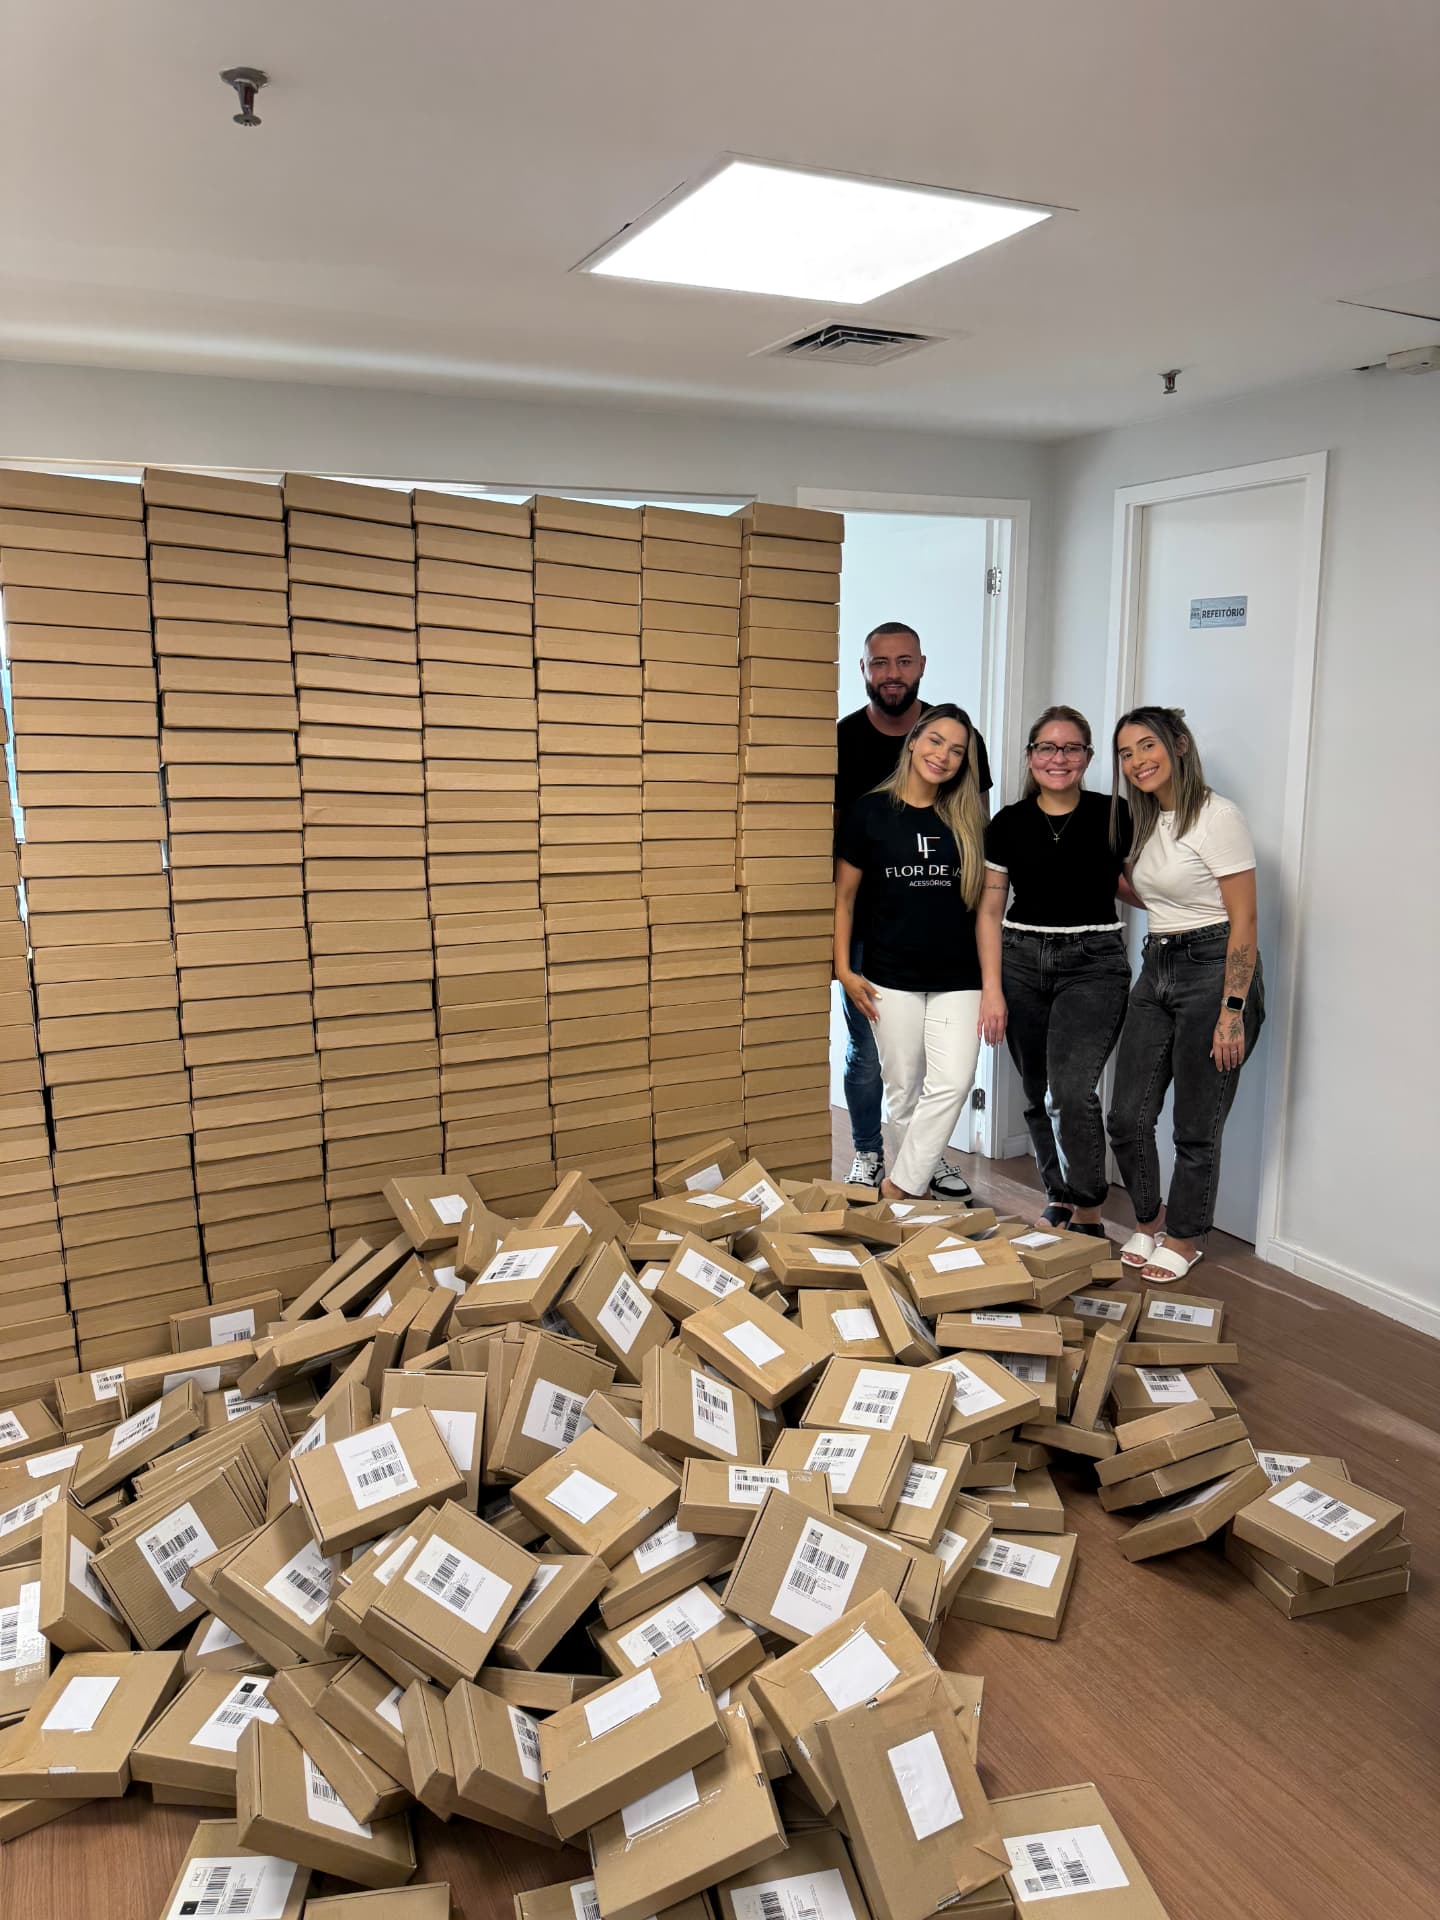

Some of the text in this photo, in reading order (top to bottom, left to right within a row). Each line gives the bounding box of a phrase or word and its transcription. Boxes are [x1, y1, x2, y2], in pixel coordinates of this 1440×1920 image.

[1201, 606, 1245, 619] REFEITÓRIO
[885, 865, 924, 878] FLOR
[928, 864, 950, 876] DE
[909, 879, 952, 887] ACESSÓRIOS
